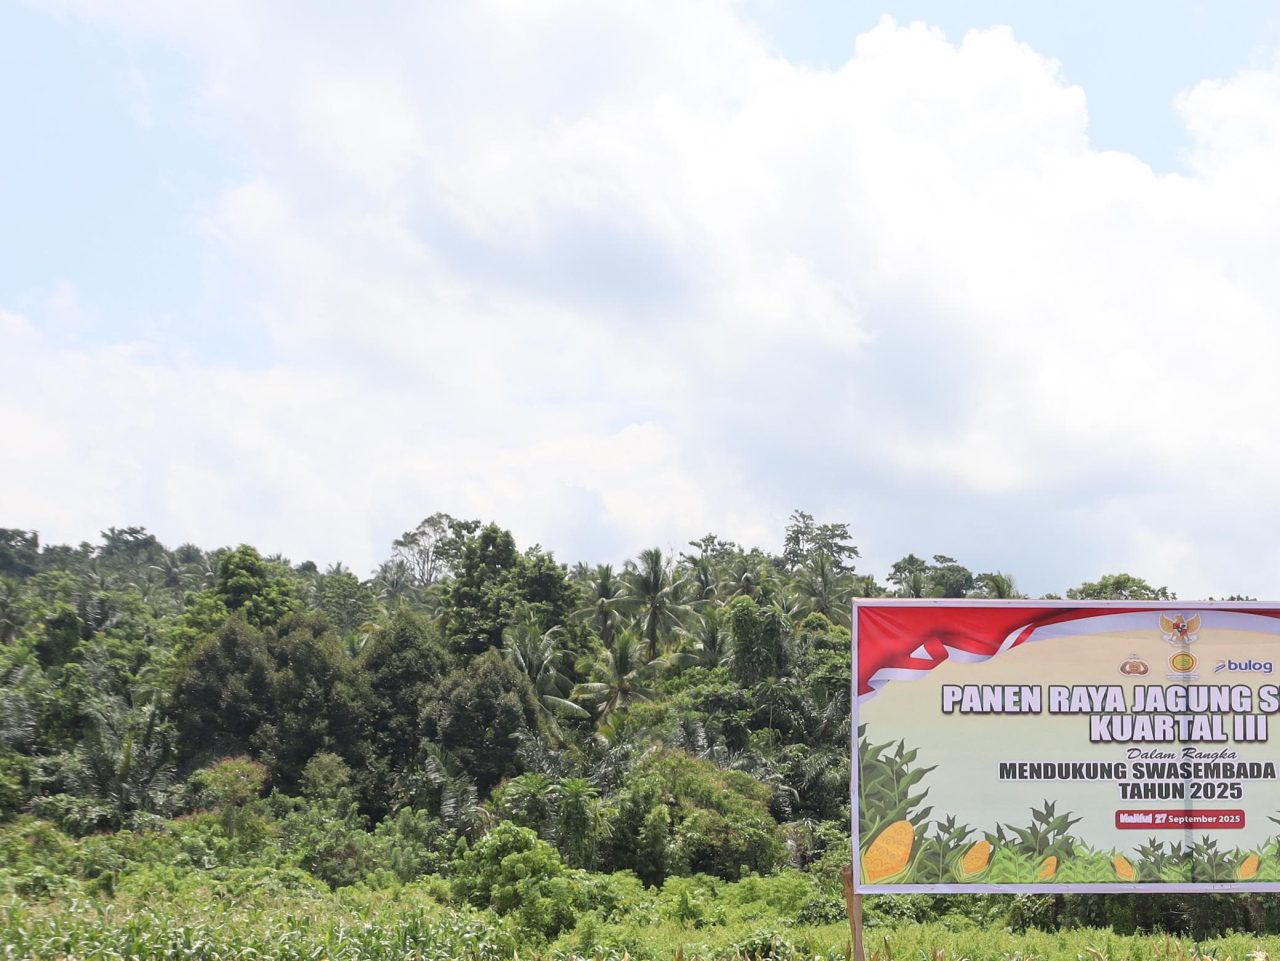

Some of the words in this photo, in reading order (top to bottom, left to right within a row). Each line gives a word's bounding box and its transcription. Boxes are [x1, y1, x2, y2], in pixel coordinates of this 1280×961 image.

[1228, 660, 1273, 673] bulog
[942, 685, 1042, 713] PANEN
[1049, 685, 1127, 713] RAYA
[1131, 684, 1252, 713] JAGUNG
[1090, 714, 1228, 742] KUARTAL
[1233, 714, 1268, 742] III
[1127, 748, 1176, 760] Dalam
[1181, 747, 1237, 764] Rangka
[999, 763, 1127, 779] MENDUKUNG
[1132, 763, 1276, 779] SWASEMBADA
[1119, 783, 1185, 800] TAHUN
[1190, 783, 1243, 799] 2025
[1155, 813, 1168, 824] 27
[1168, 815, 1216, 826] September
[1218, 815, 1241, 823] 2025
